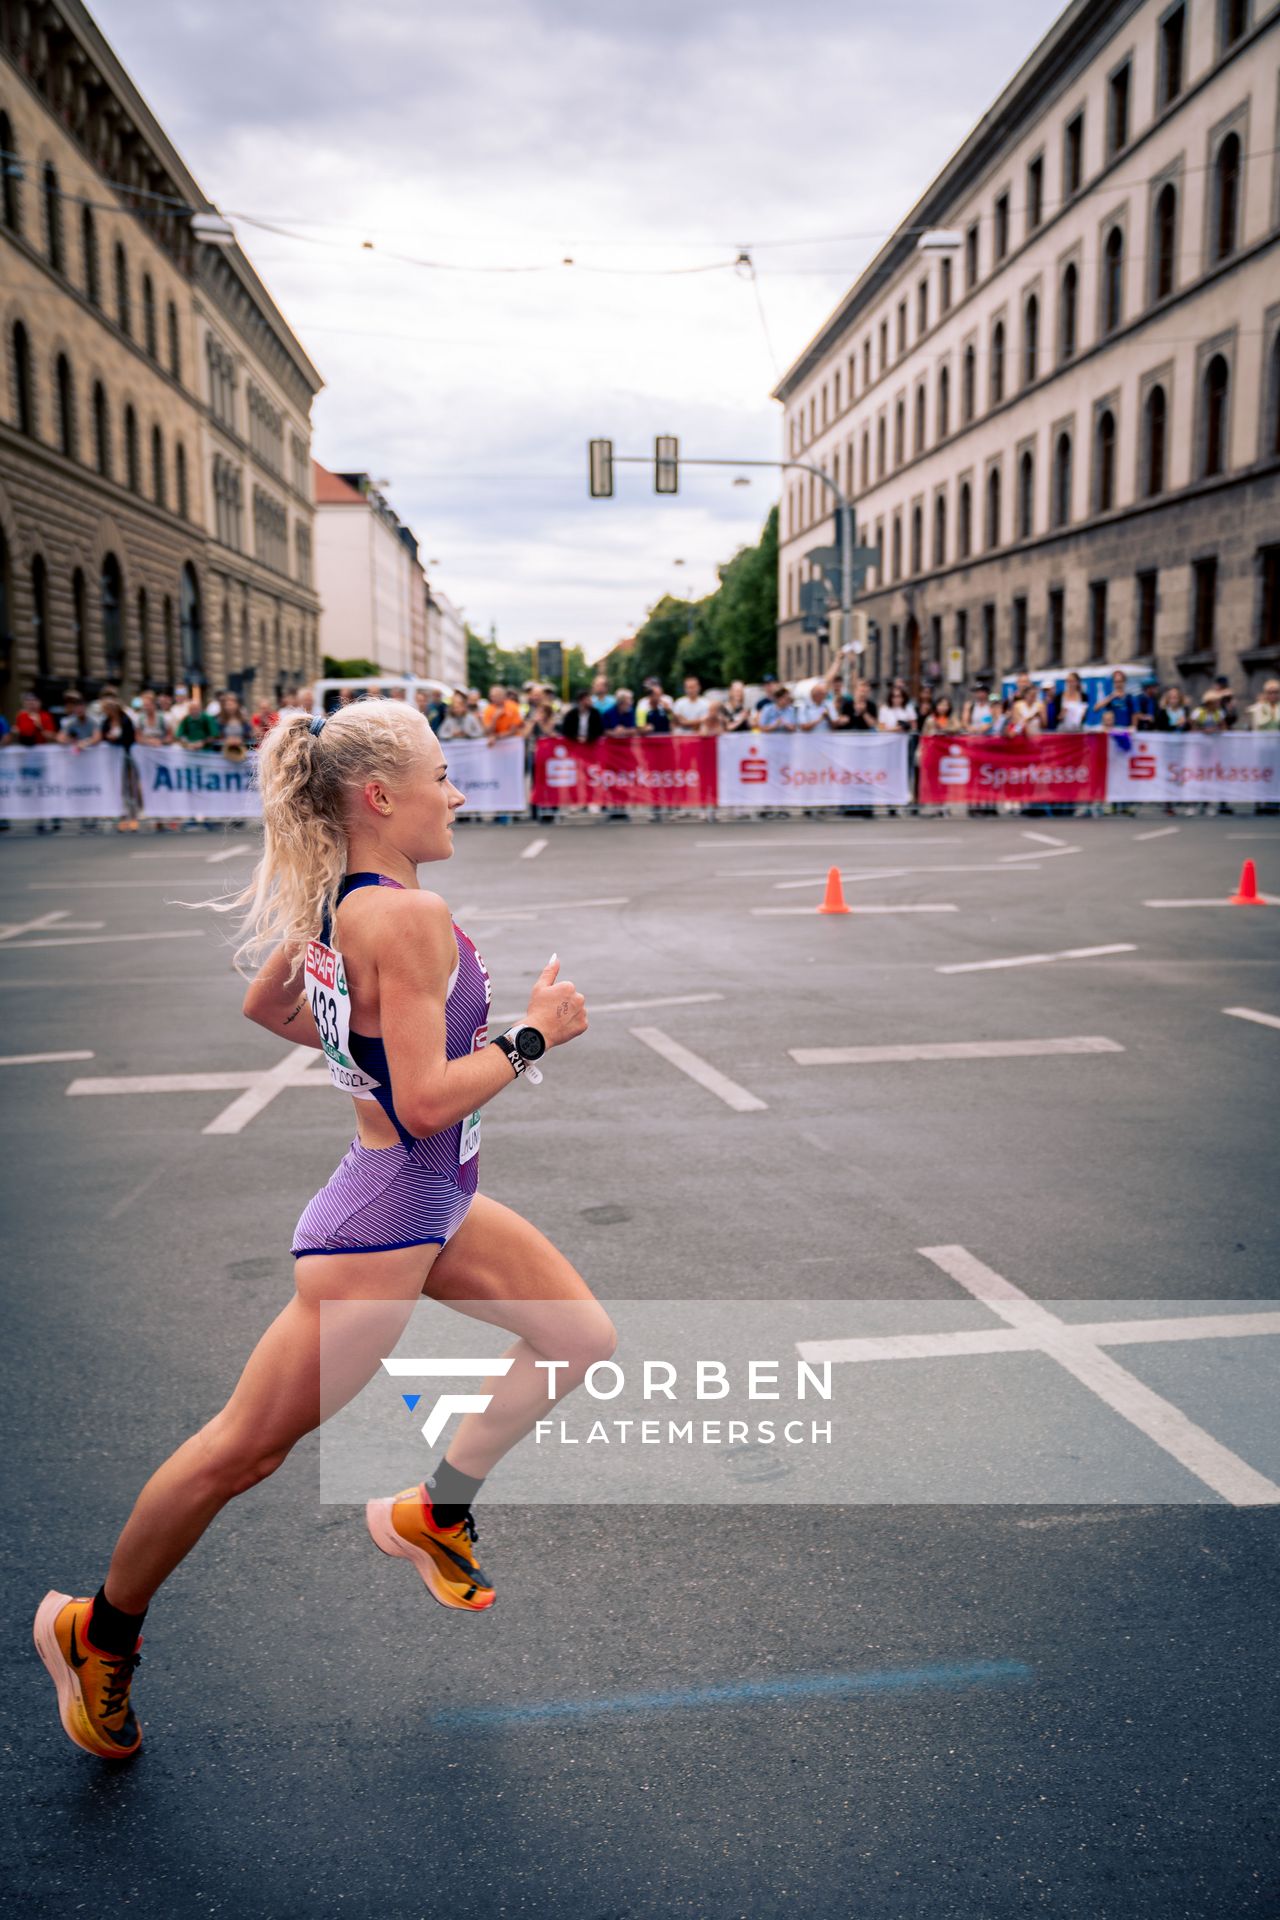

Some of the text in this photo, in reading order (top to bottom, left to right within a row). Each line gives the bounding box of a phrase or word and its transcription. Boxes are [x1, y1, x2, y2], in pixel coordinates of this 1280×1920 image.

[587, 765, 699, 789] Sparkasse
[780, 765, 888, 787] Sparkasse
[979, 764, 1089, 788] Sparkasse
[1167, 763, 1274, 786] Sparkasse
[307, 943, 335, 985] SPAR
[312, 986, 339, 1050] 433
